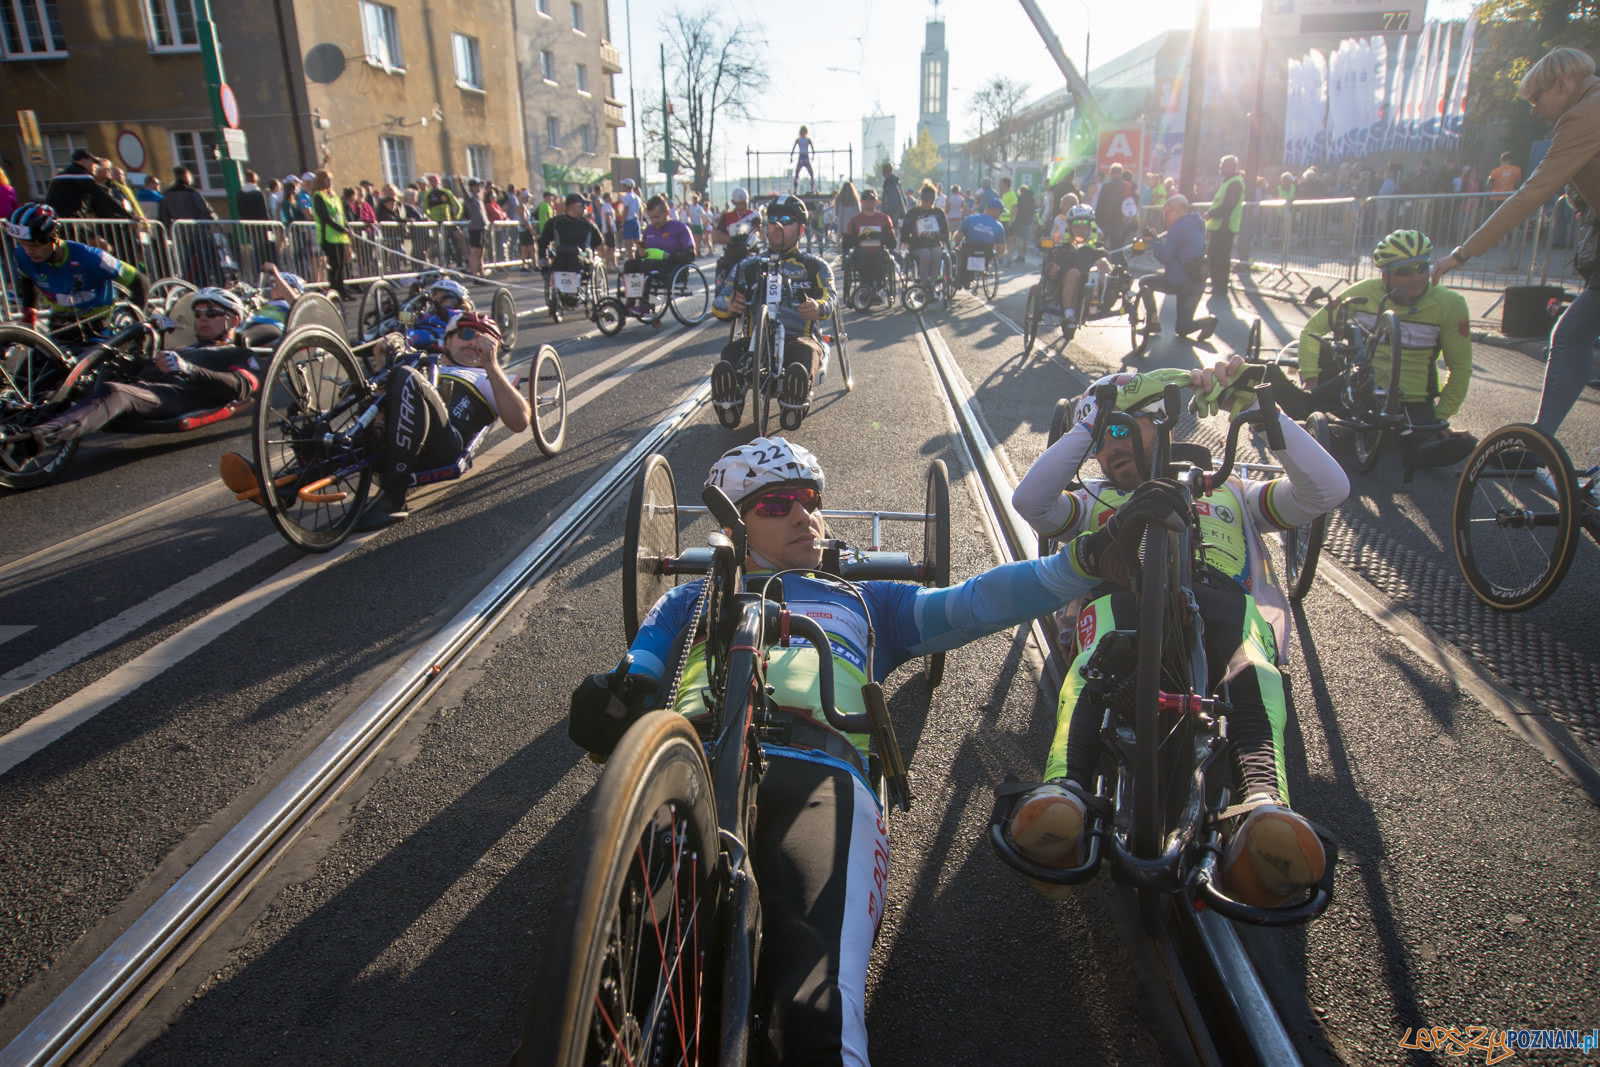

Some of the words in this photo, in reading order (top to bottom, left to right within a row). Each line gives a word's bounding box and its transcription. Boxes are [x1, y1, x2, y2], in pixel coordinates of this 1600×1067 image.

[1383, 12, 1409, 30] 77
[1105, 133, 1133, 158] A
[1469, 438, 1526, 483] CORIMA
